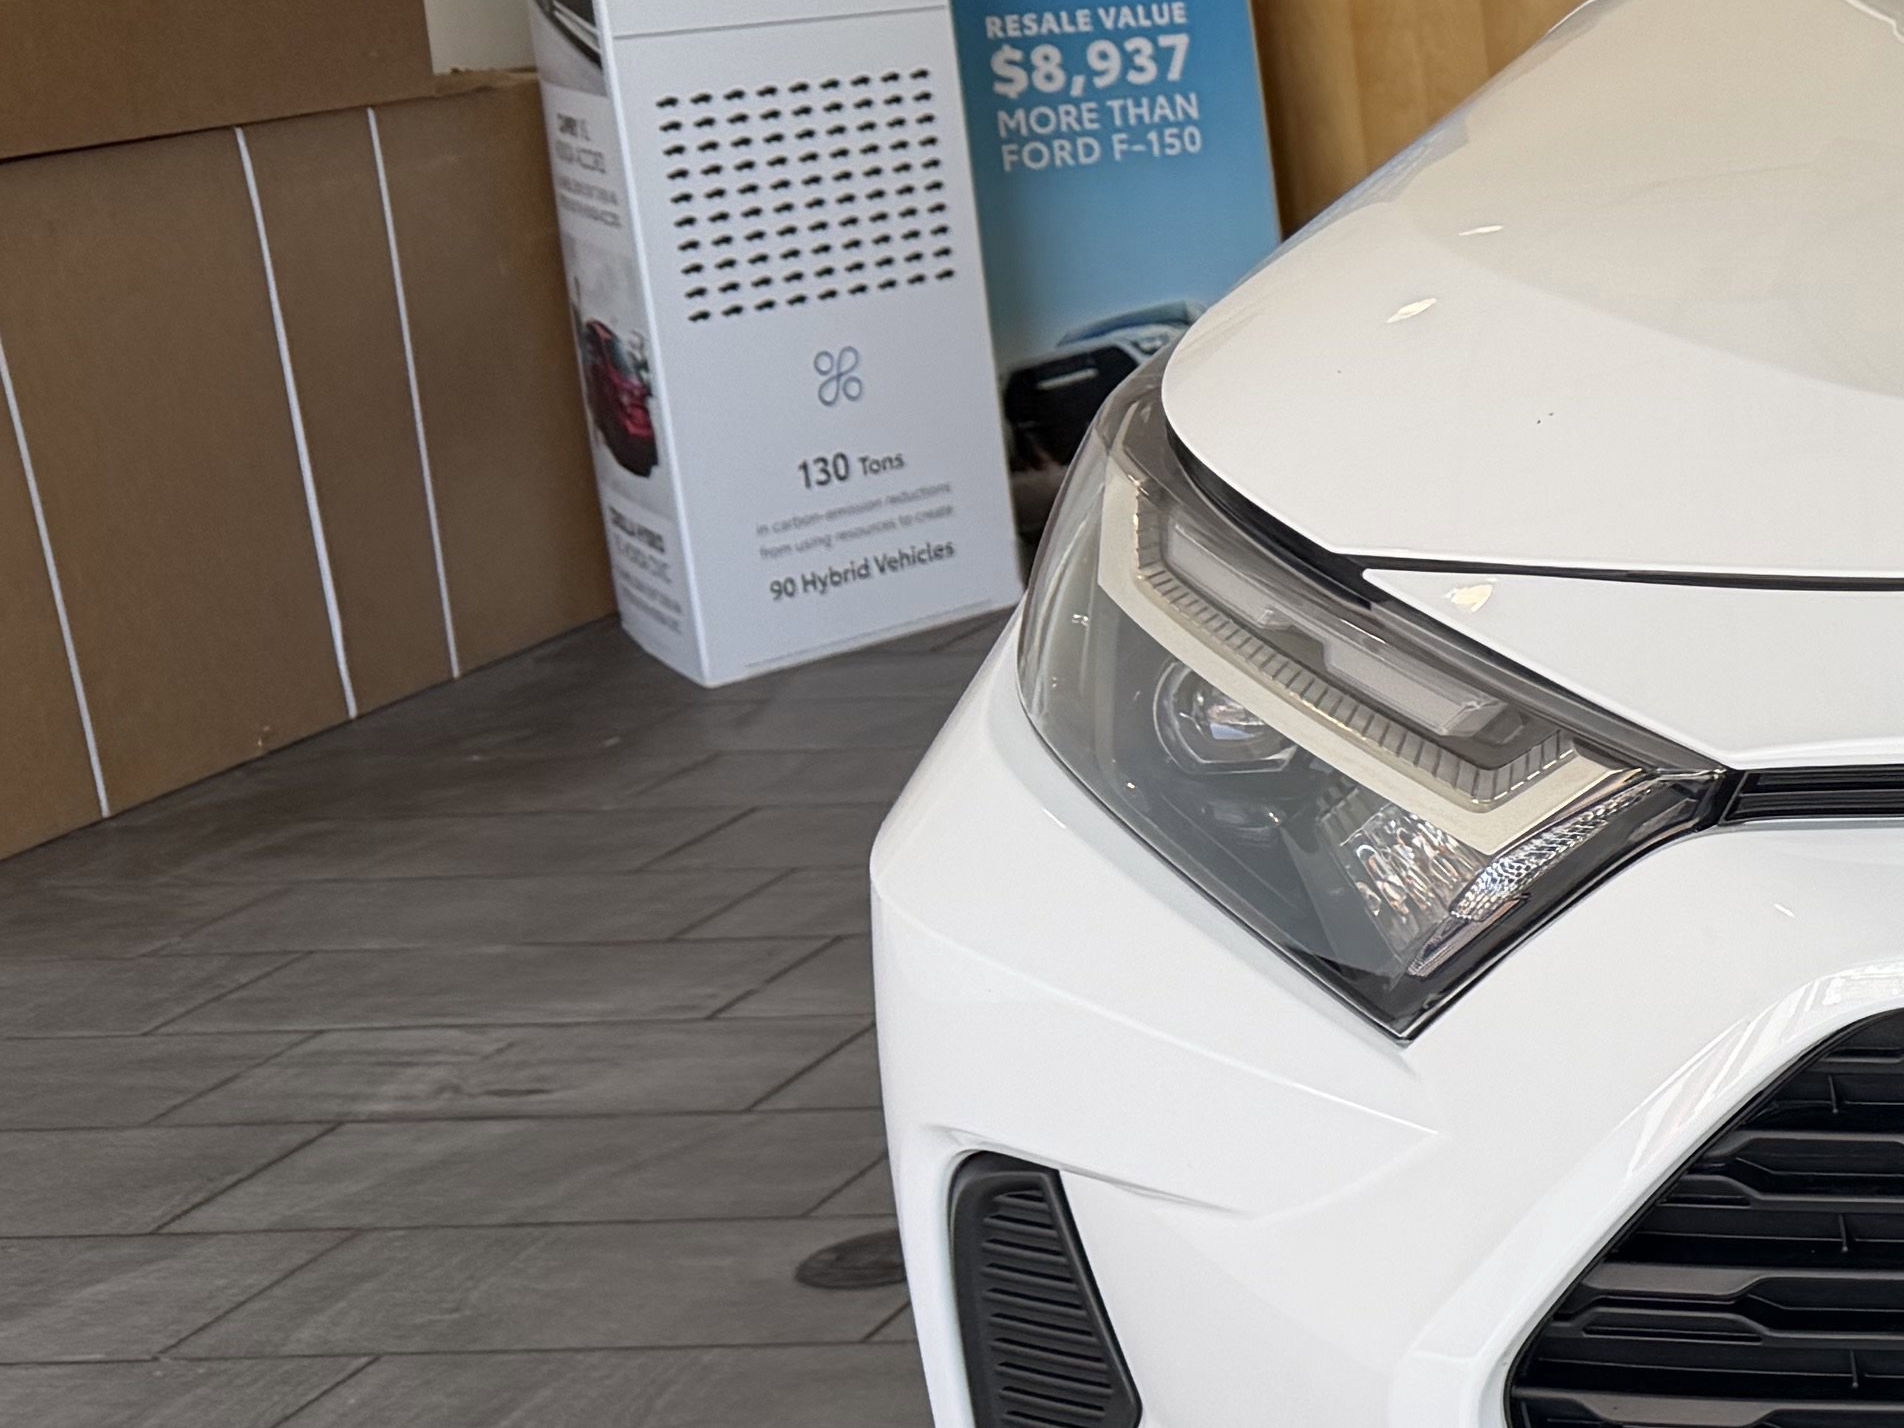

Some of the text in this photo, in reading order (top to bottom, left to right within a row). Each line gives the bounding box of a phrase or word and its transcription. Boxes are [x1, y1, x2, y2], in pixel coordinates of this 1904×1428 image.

[985, 1, 1187, 39] RESALE VALUE
[990, 33, 1190, 99] $8,937
[997, 92, 1200, 139] MORE THAN
[1001, 125, 1202, 172] FORD F-150
[799, 452, 905, 489] 130 Tons
[769, 540, 956, 602] 90 Hybrid Vehicles
